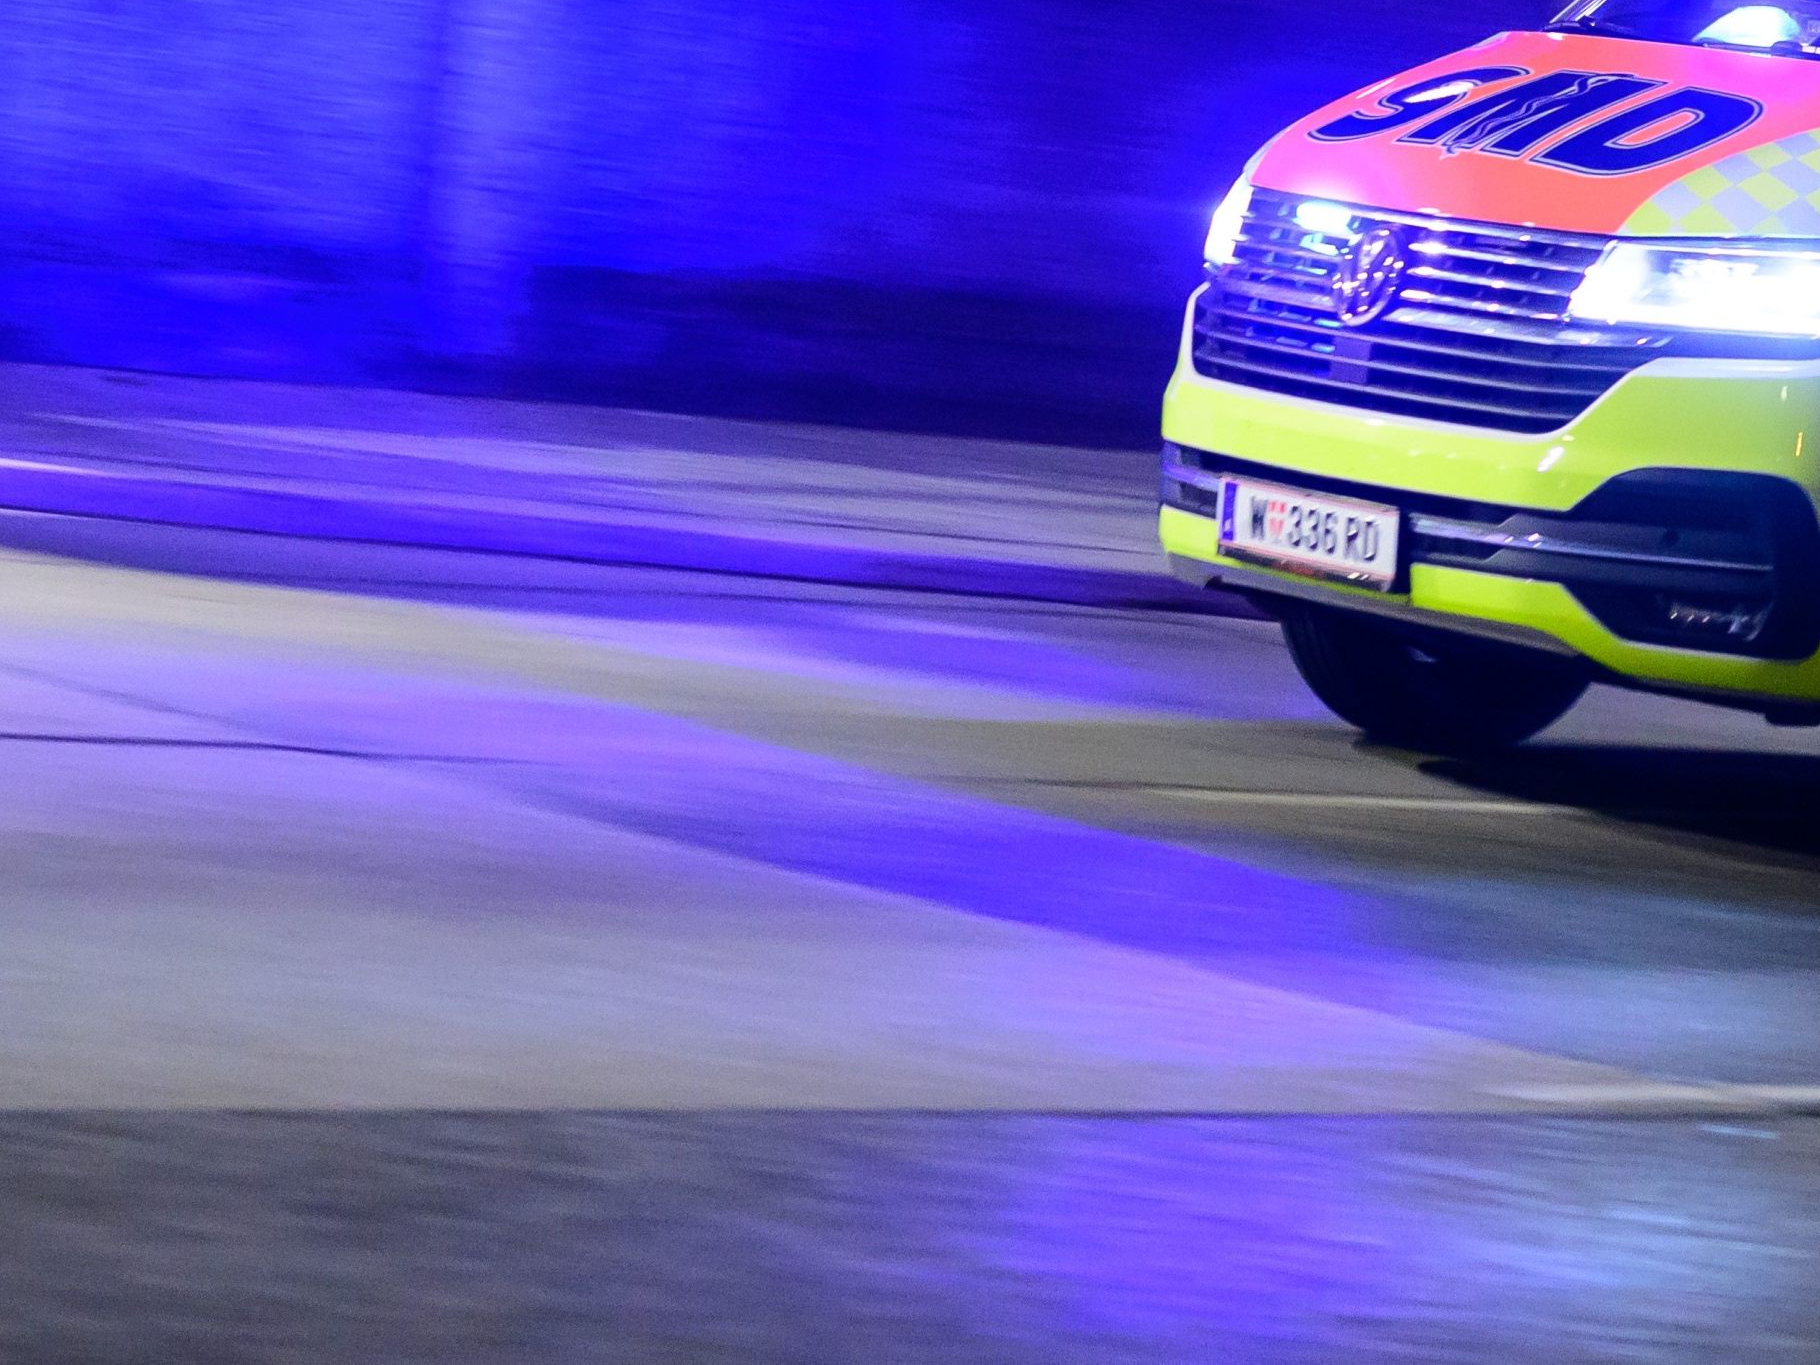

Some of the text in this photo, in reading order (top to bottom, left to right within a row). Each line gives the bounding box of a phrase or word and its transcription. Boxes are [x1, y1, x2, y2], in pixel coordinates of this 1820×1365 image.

[1306, 65, 1764, 176] SMD
[1251, 497, 1267, 540] W
[1289, 505, 1336, 554] 336
